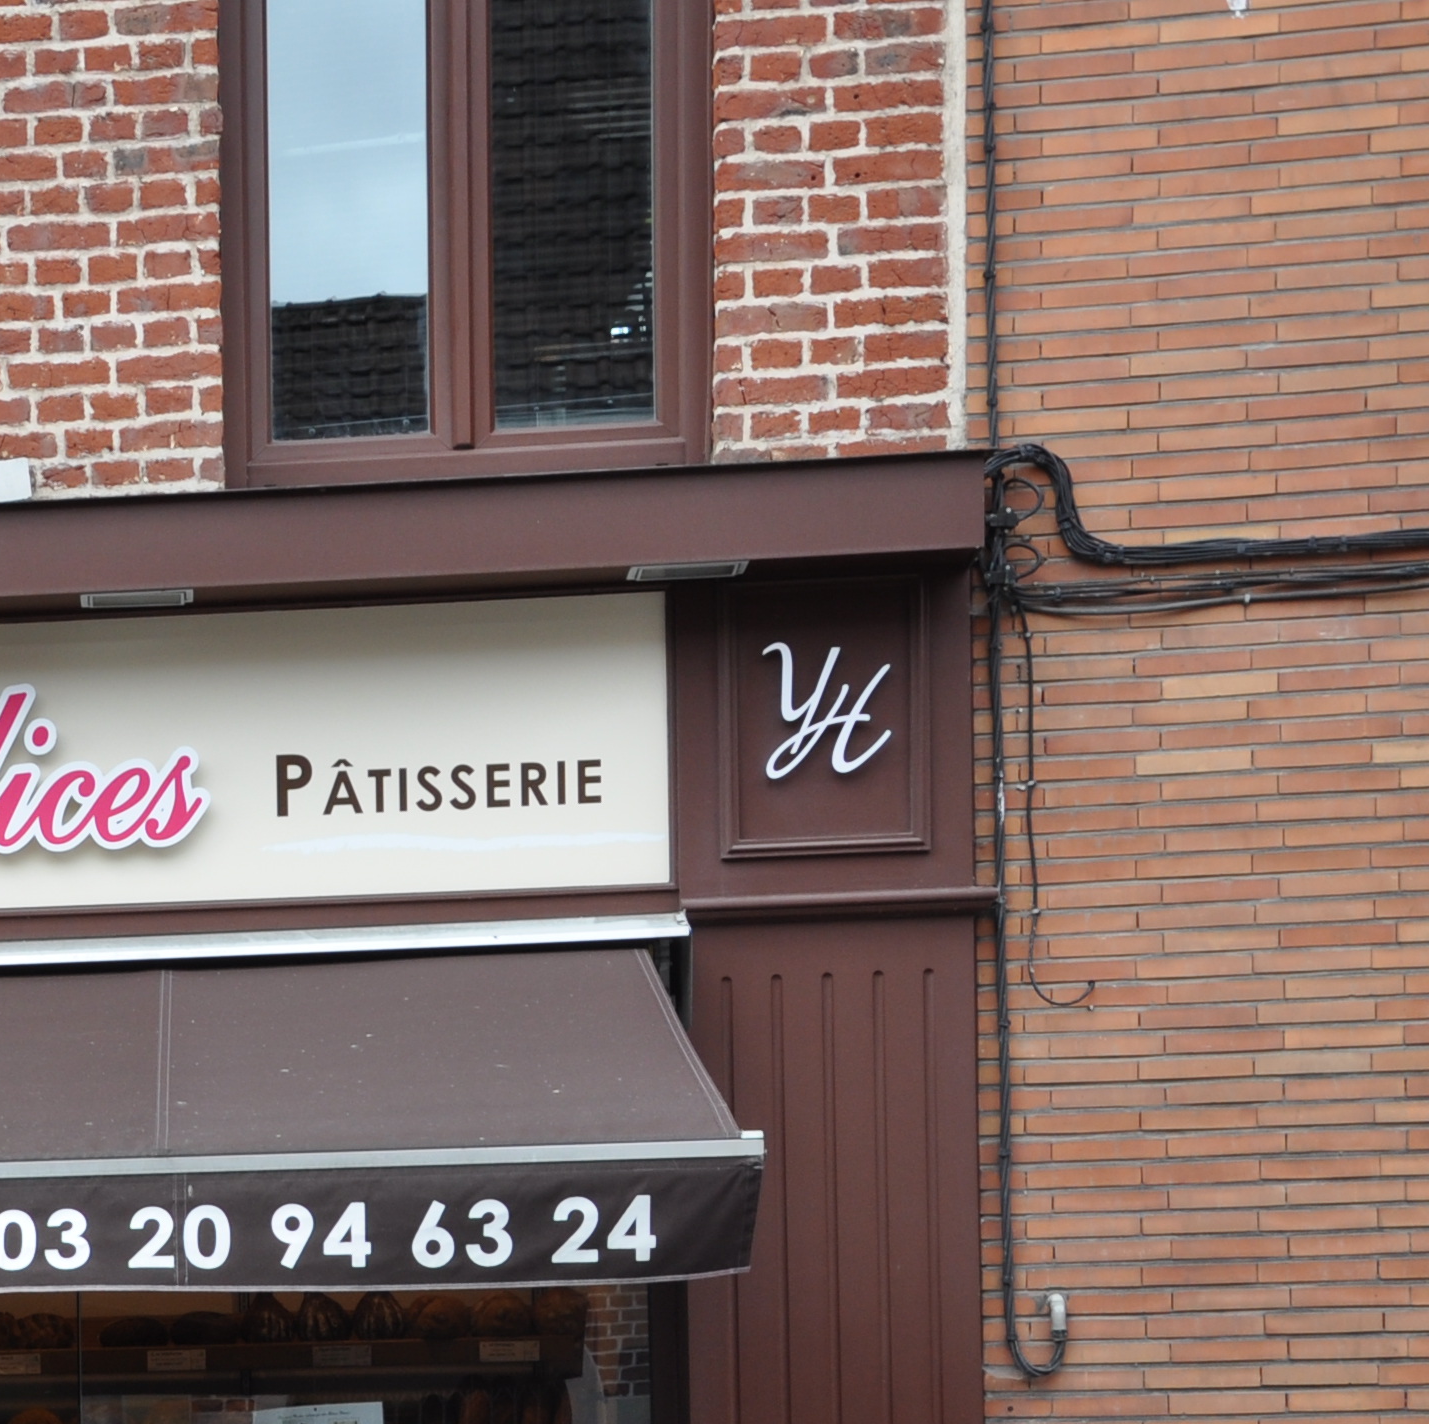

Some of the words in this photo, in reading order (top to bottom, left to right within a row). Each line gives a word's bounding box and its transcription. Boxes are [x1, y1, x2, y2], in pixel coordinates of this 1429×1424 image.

[761, 641, 893, 781] YH
[274, 754, 603, 818] PÂTISSERIE
[126, 1204, 232, 1270] 20
[269, 1201, 373, 1270] 94
[410, 1198, 514, 1269] 63
[550, 1194, 658, 1264] 24
